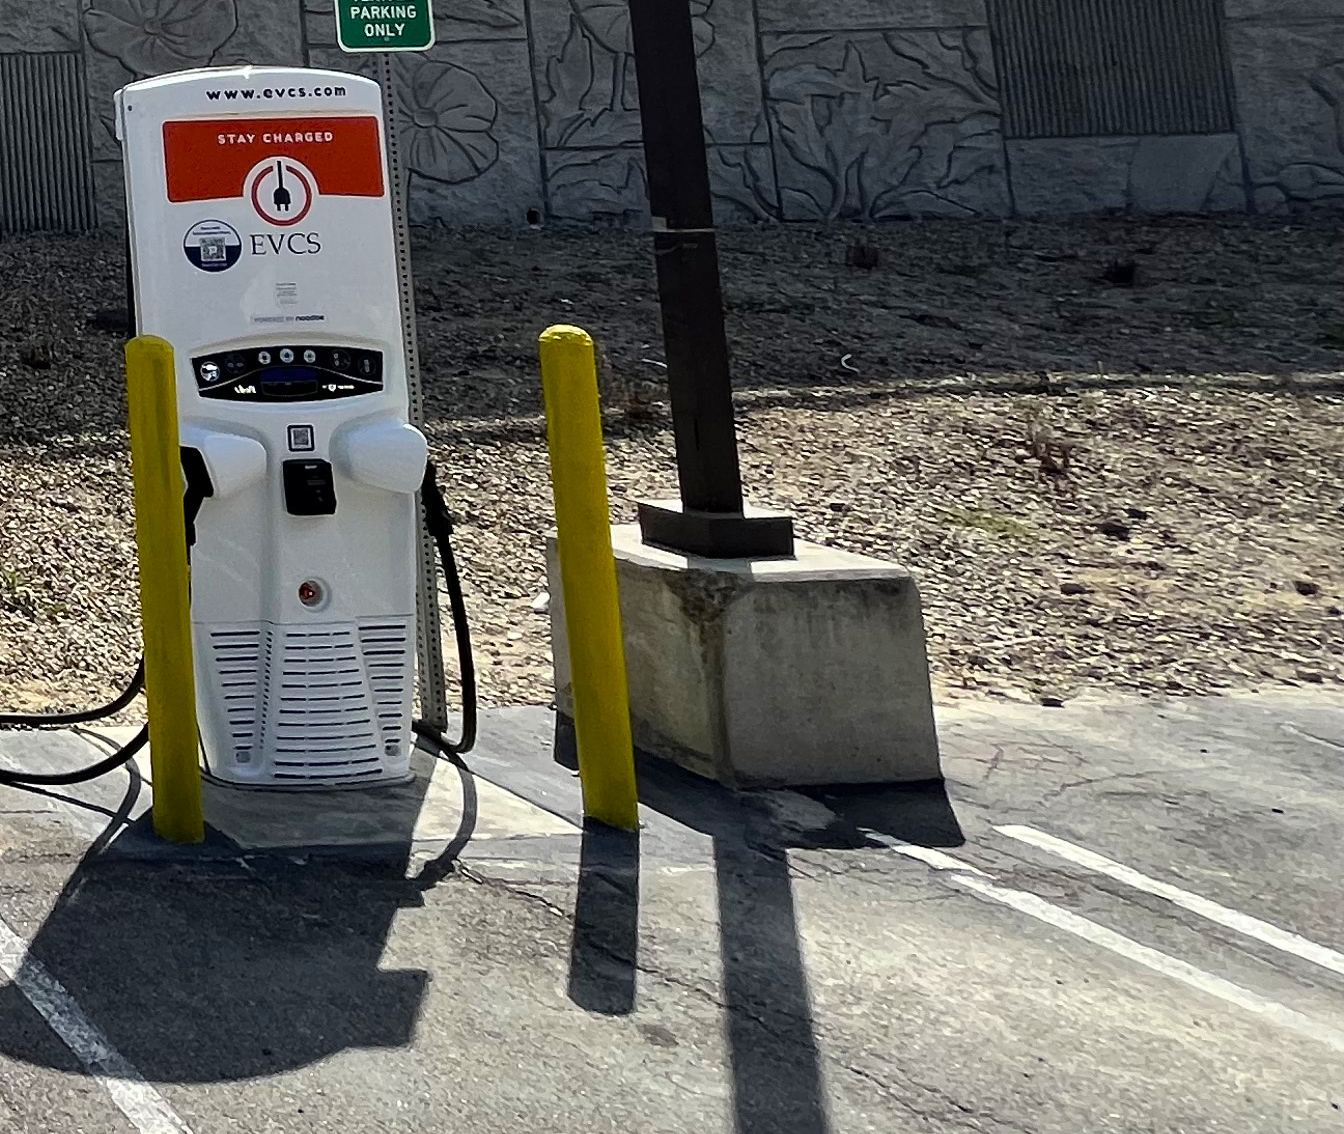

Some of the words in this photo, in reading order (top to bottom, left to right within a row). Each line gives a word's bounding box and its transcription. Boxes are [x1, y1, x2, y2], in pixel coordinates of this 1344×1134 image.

[350, 5, 417, 20] PARKING
[364, 23, 405, 37] ONLY
[205, 85, 346, 101] www.evcs.com
[217, 134, 256, 145] STAY
[262, 131, 333, 144] CHARGED
[249, 232, 321, 256] EVCS
